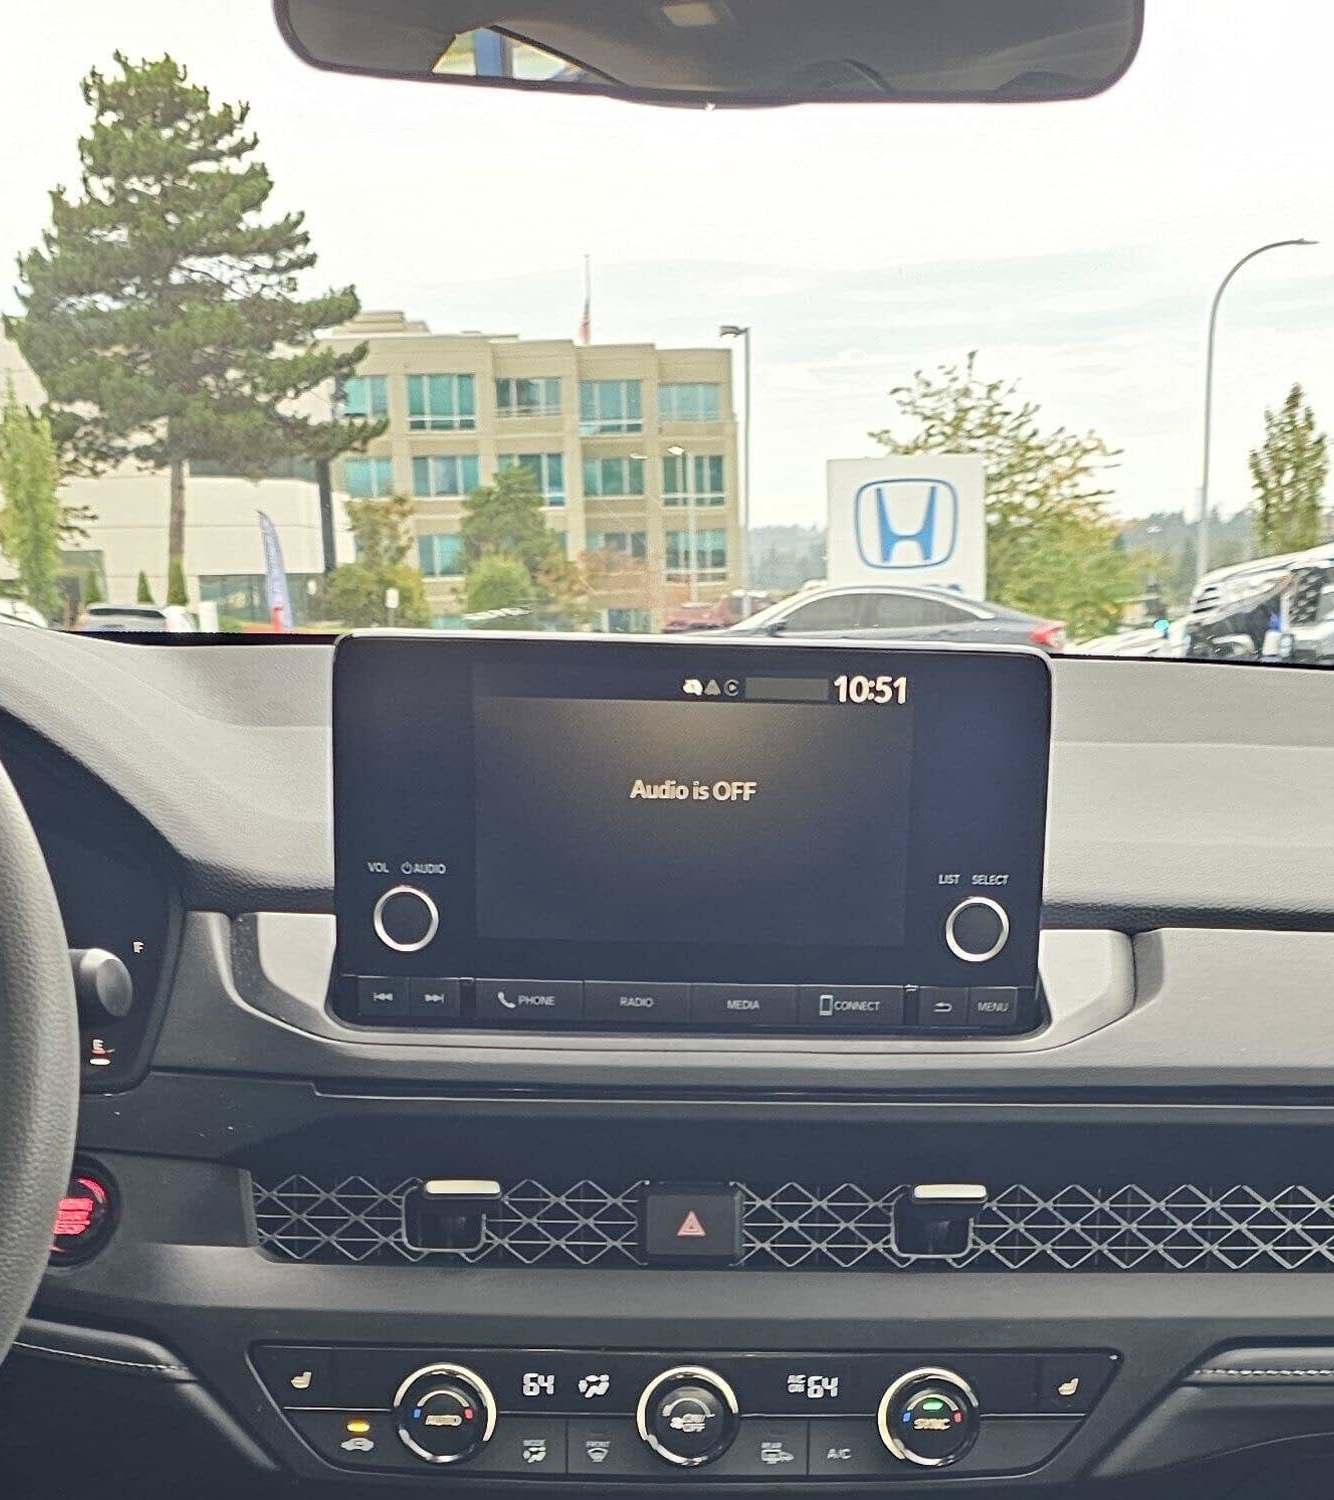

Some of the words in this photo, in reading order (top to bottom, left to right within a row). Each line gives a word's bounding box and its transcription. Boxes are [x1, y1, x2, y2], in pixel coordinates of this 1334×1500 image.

[833, 675, 908, 704] 10:51
[629, 779, 689, 800] Audio
[692, 780, 710, 800] is
[712, 781, 758, 801] OFF
[367, 862, 390, 873] VOL
[413, 863, 447, 874] AUDIO
[938, 874, 961, 885] LIST
[971, 874, 1009, 885] SELECT
[132, 941, 145, 953] F
[518, 995, 555, 1007] PHONE
[620, 997, 654, 1008] RADIO
[727, 1000, 760, 1010] MEDIA
[834, 1000, 881, 1012] CONNECT
[977, 1002, 1010, 1012] MENU
[522, 1373, 555, 1397] 64
[806, 1375, 839, 1399] 64
[827, 1448, 852, 1460] A/C
